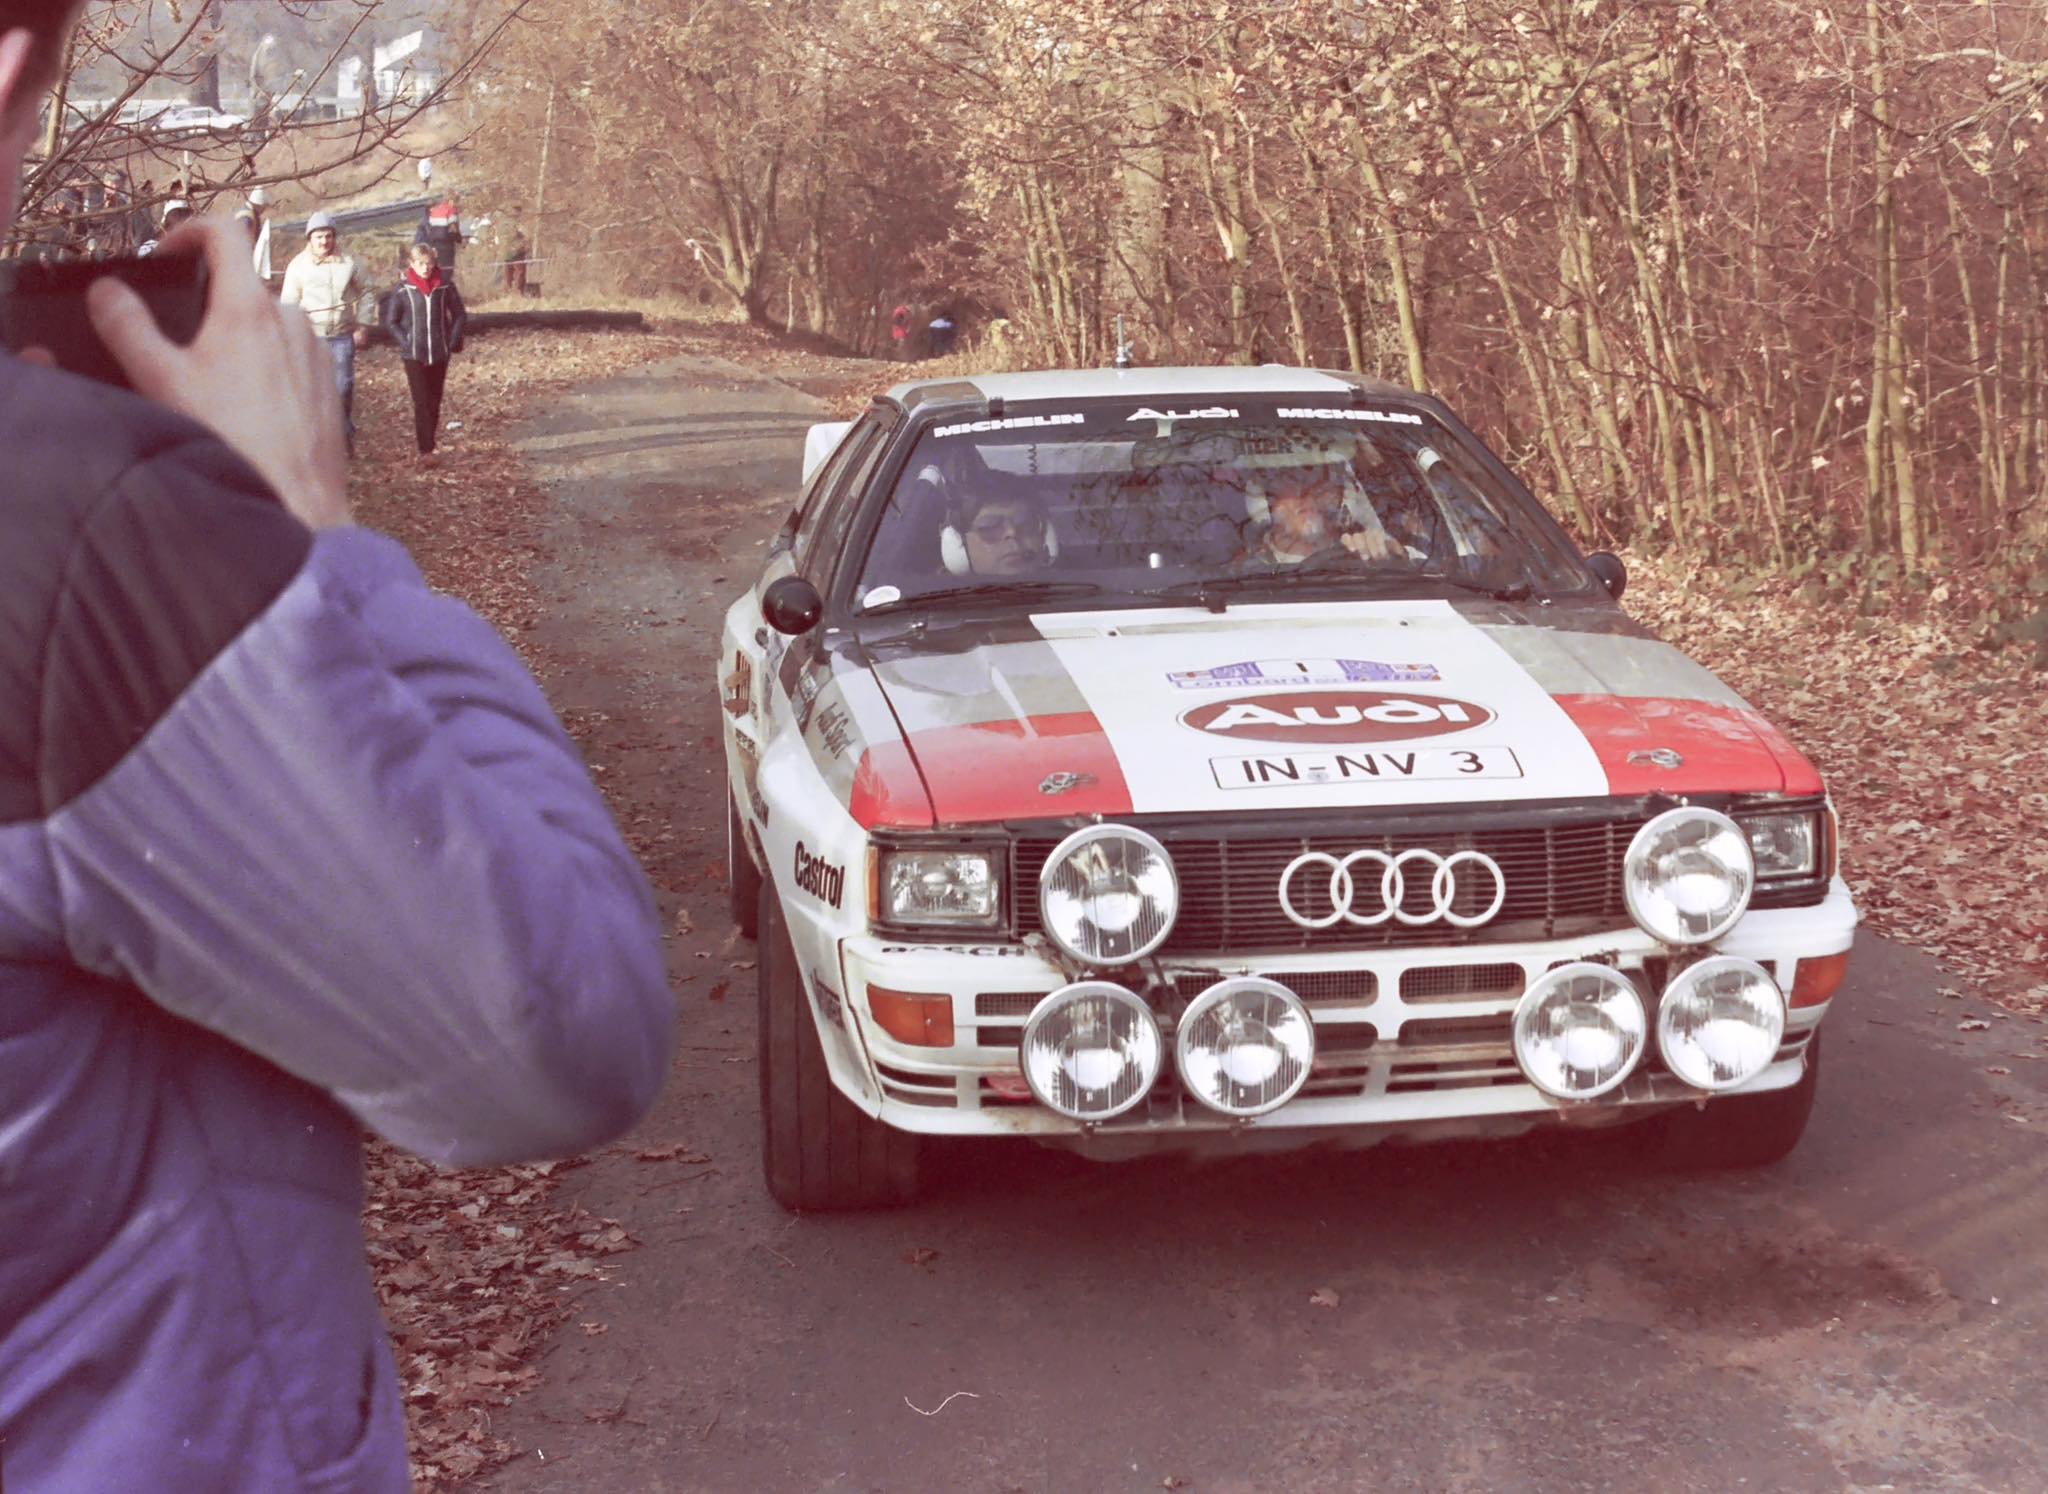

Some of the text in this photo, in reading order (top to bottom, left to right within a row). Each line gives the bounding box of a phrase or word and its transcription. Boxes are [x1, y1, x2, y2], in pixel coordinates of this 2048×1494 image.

[933, 413, 1085, 438] MICHELIN
[1276, 407, 1423, 425] MICHELIN
[1450, 750, 1485, 774] 3
[794, 840, 845, 909] Castrol
